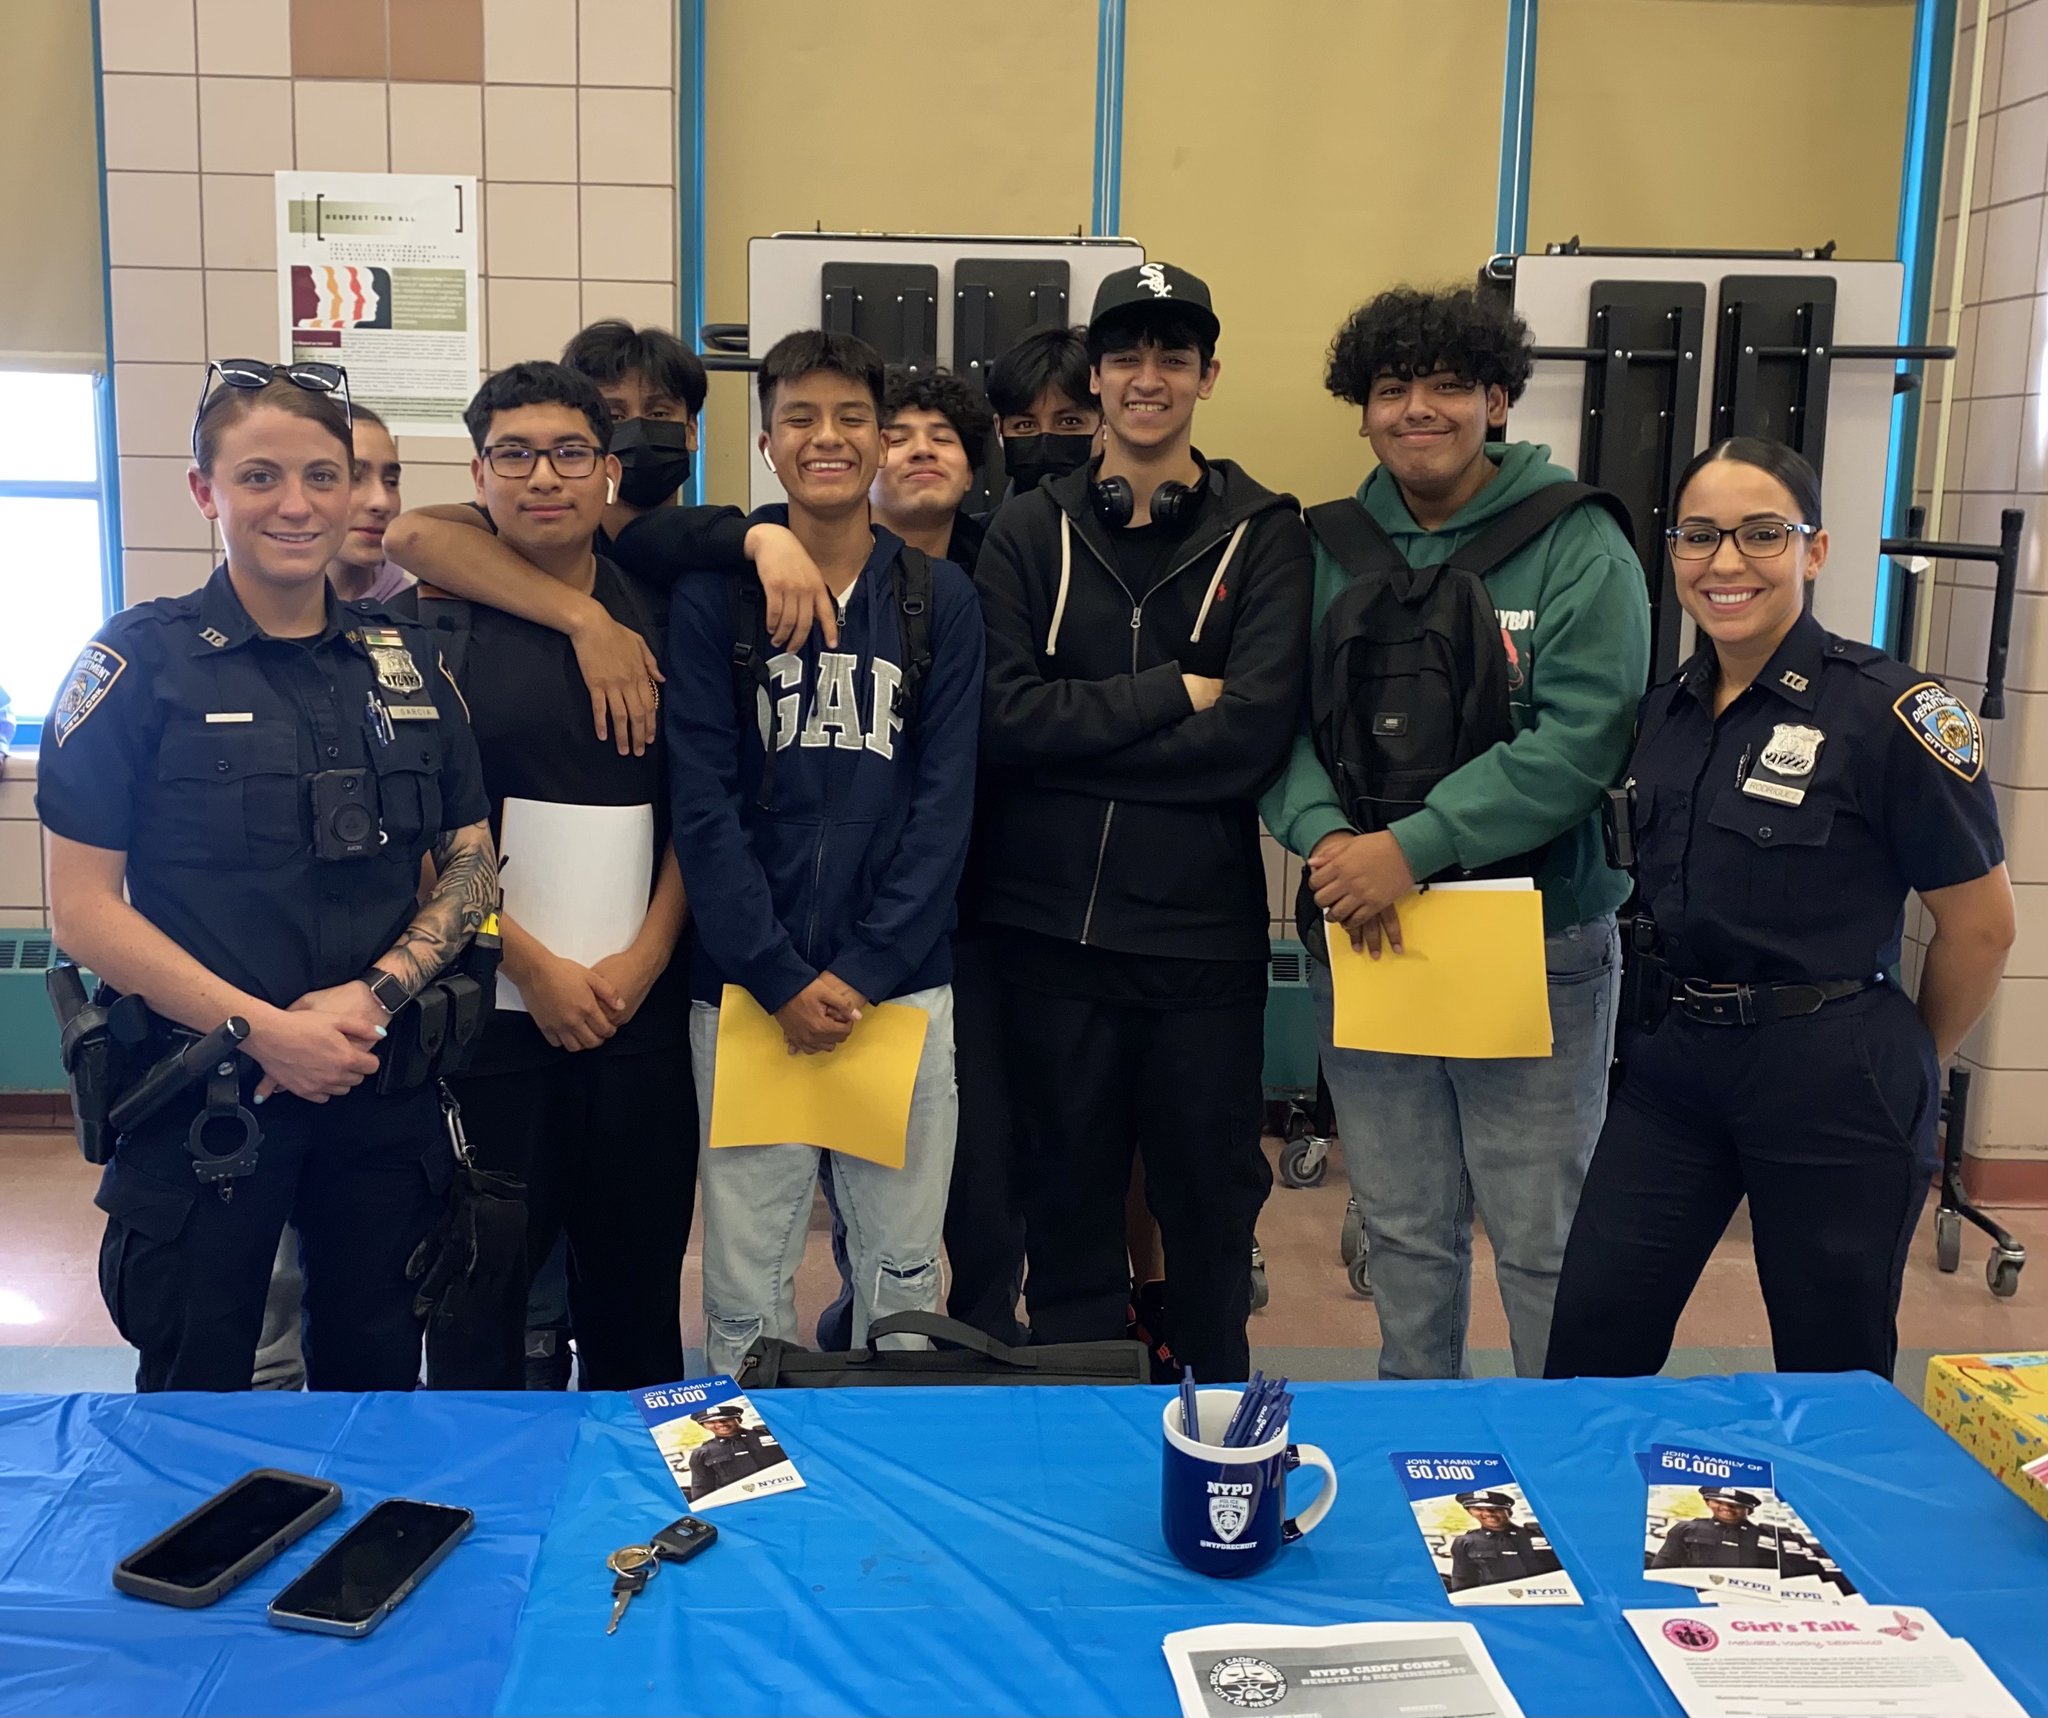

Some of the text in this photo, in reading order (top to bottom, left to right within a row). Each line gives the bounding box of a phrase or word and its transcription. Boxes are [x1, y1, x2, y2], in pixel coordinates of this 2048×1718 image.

[1494, 609, 1536, 630] YBOY
[1924, 732, 1962, 765] CITY OF
[1748, 782, 1799, 800] RODRIGUEZ
[643, 1389, 666, 1399] JOIN
[677, 1382, 712, 1393] FAMILY
[644, 1389, 707, 1409] 50,000
[1254, 1419, 1267, 1437] NYPD
[1270, 1427, 1281, 1441] YPD
[1405, 1458, 1431, 1466] JOIN
[1661, 1450, 1690, 1460] JOIN
[1703, 1456, 1744, 1469] FAMILY
[1747, 1464, 1763, 1472] OF
[1661, 1455, 1731, 1479] 50,000
[758, 1475, 794, 1488] NYPD
[1406, 1465, 1475, 1481] 50,000
[1206, 1481, 1253, 1496] NYPD
[1527, 1588, 1567, 1596] NYPD
[1728, 1577, 1772, 1592] NYPD
[1730, 1620, 1861, 1633] Girl's Talk
[1209, 1657, 1285, 1685] POLICE CADET CORPS
[1301, 1674, 1360, 1686] BENEFITS
[1372, 1667, 1467, 1680] REQUIREMENTS
[1309, 1660, 1451, 1678] NYPD CADET CORPS
[1214, 1687, 1235, 1702] CITY
[1249, 1699, 1274, 1708] NEW
[1271, 1684, 1287, 1700] YORK
